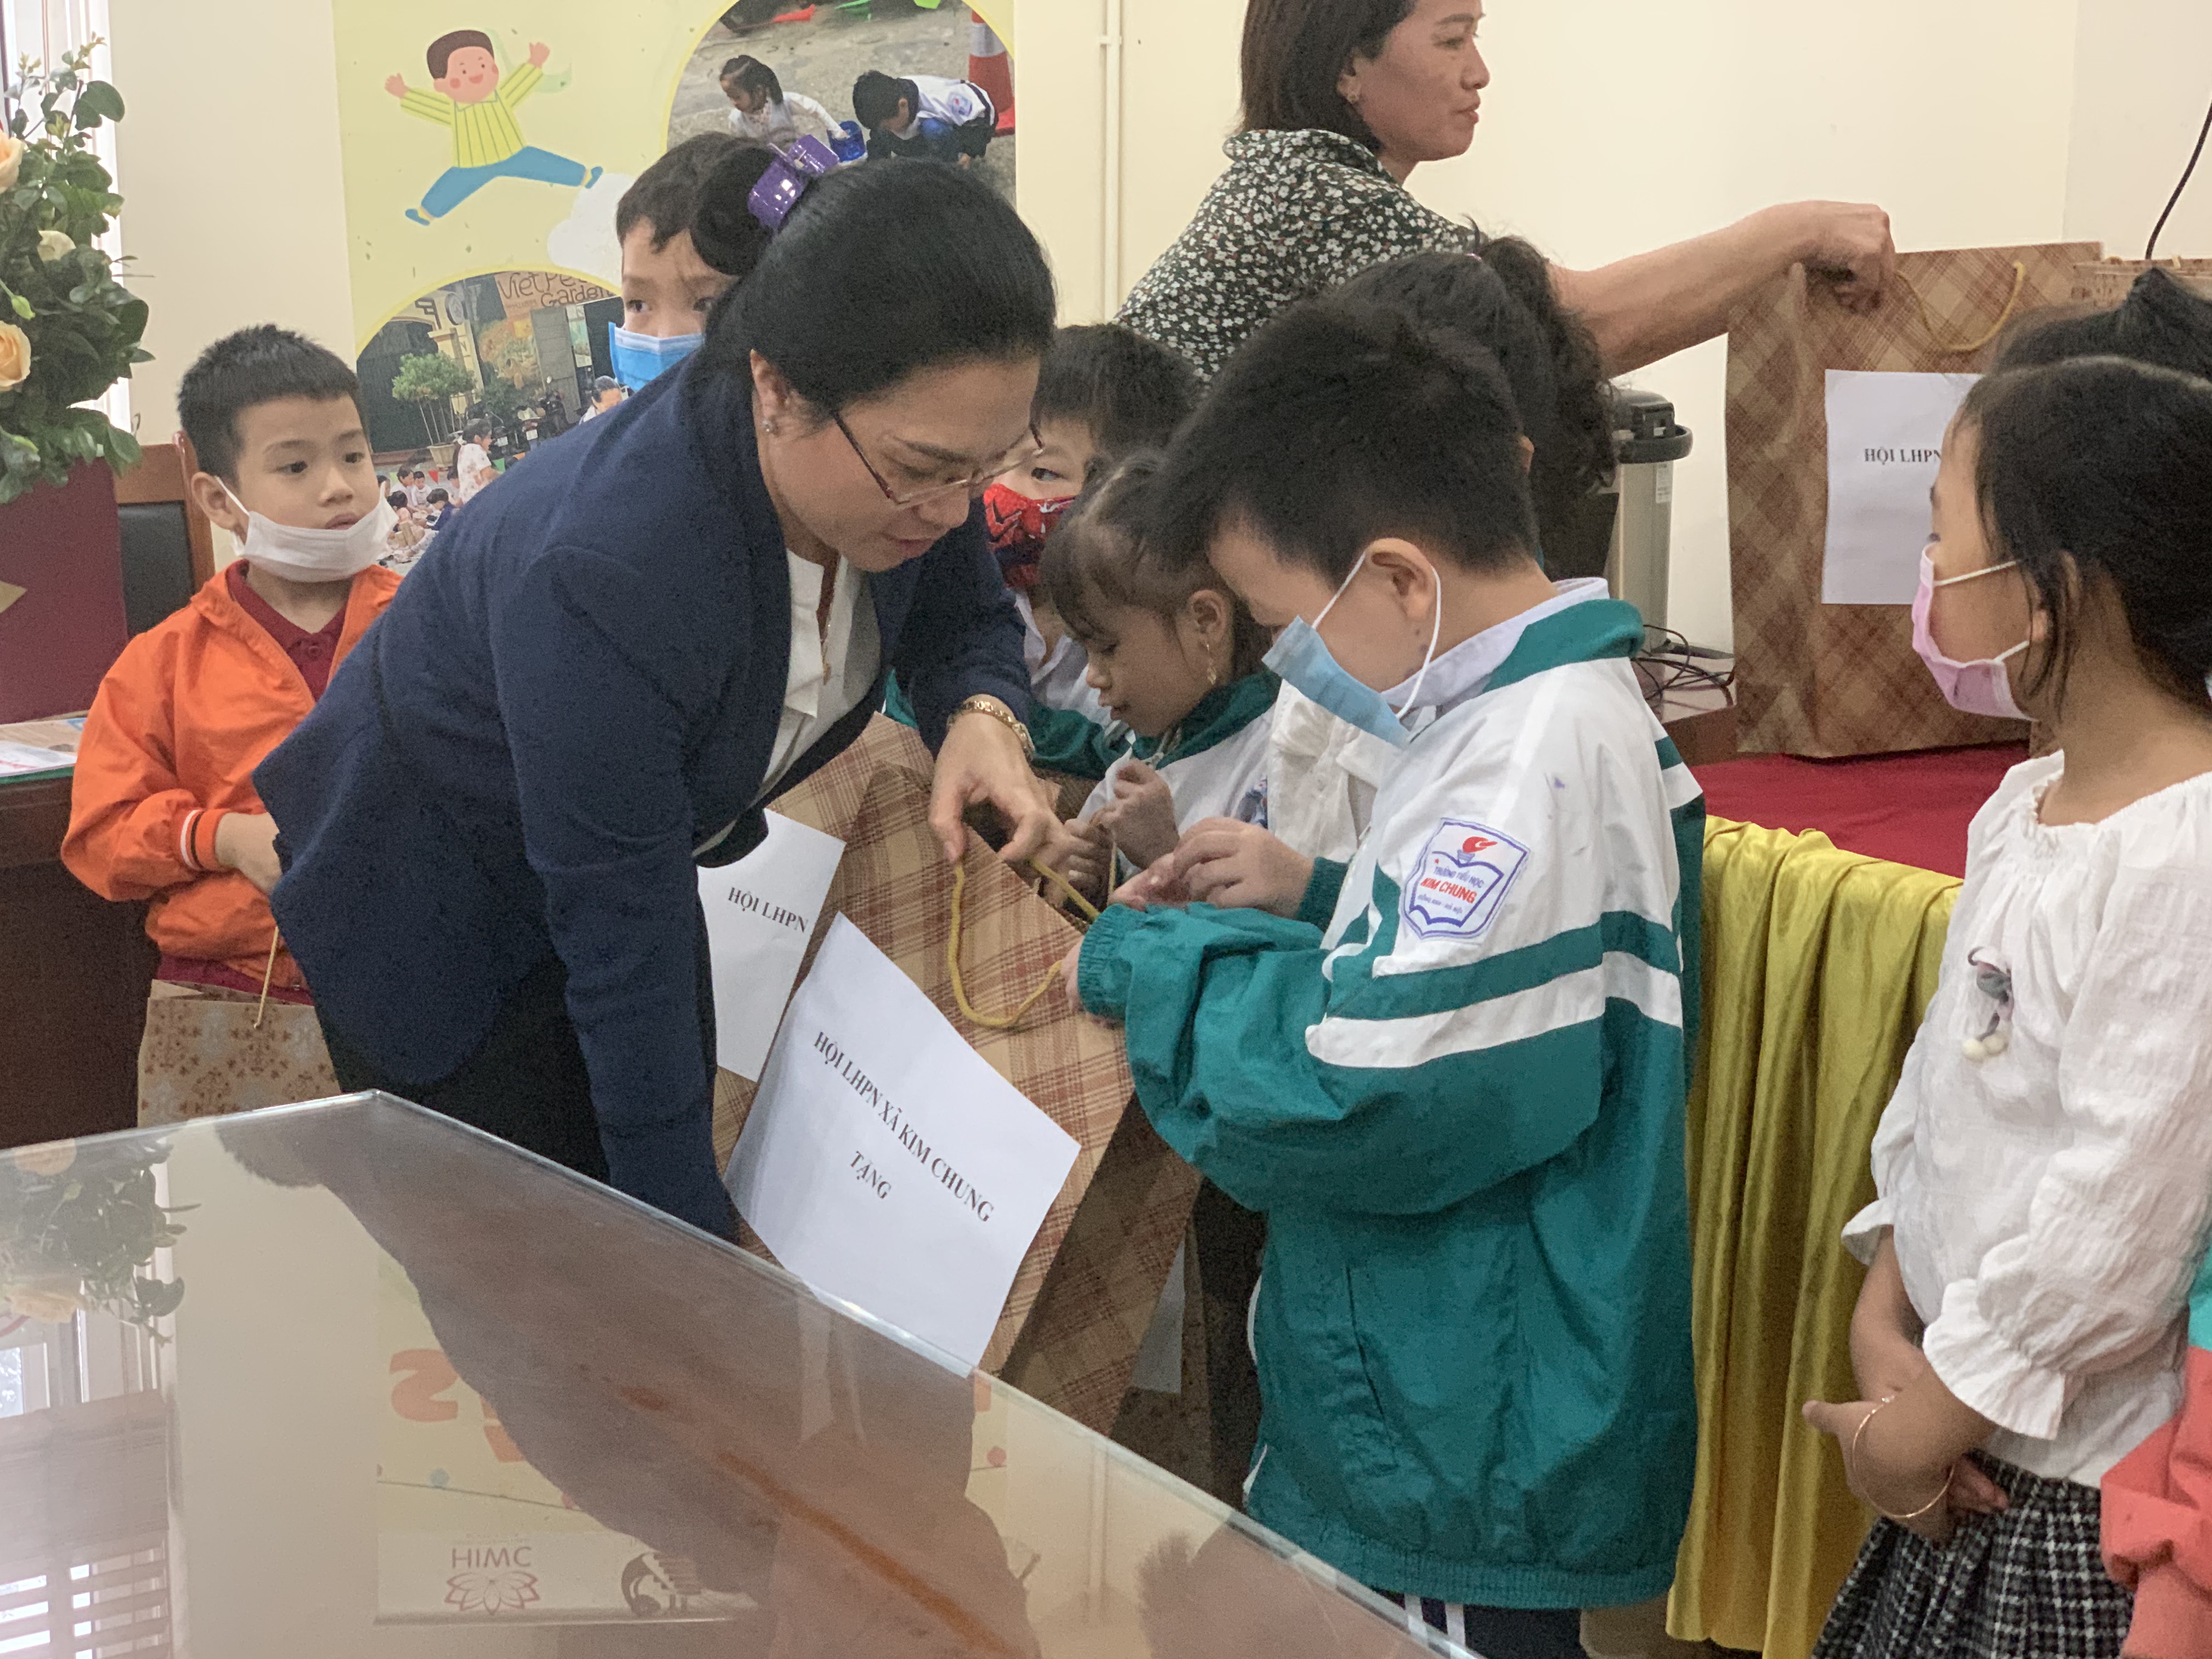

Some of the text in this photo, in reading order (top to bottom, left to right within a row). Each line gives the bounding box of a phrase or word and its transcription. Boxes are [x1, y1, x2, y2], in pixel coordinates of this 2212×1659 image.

[1864, 446, 1895, 465] HỘI
[728, 887, 809, 933] HỘI LHPN
[1420, 877, 1442, 890] KIM
[1438, 881, 1477, 904] CHUNG
[814, 1031, 995, 1222] HỘI LHPN XÃ KIM CHUNG
[850, 1150, 892, 1199] TẶNG
